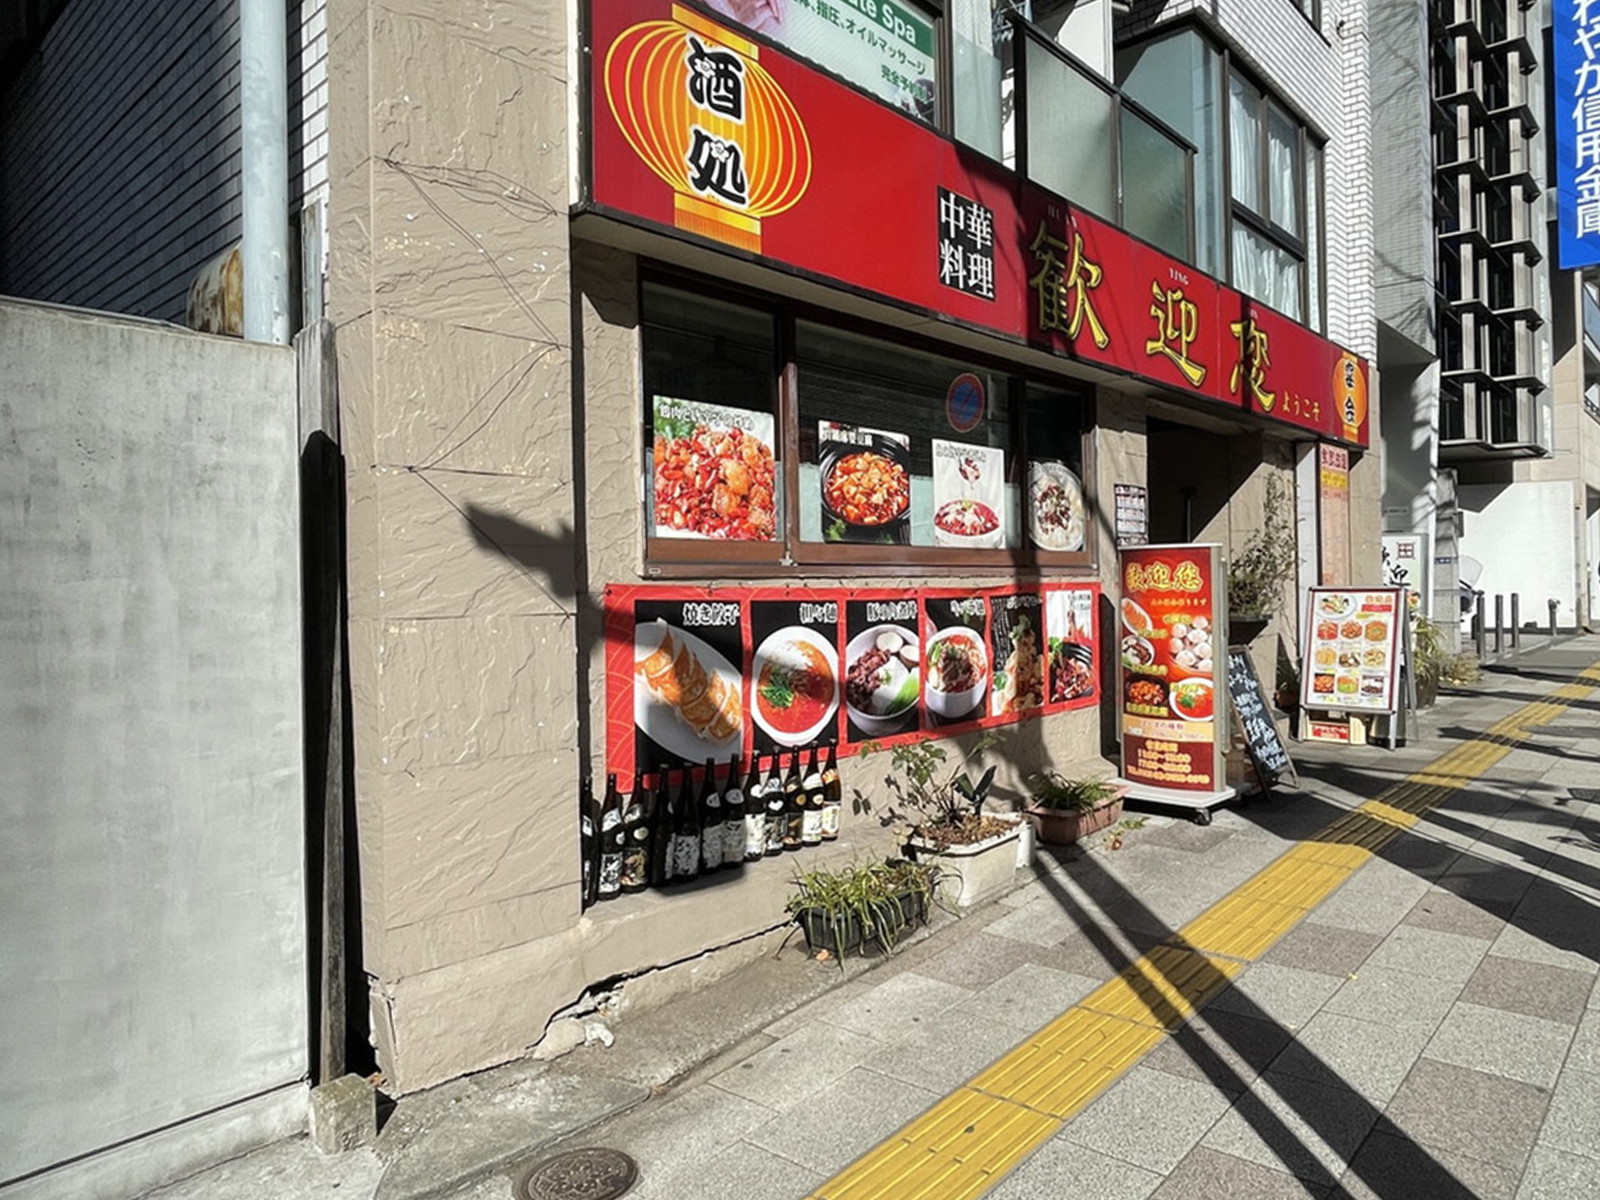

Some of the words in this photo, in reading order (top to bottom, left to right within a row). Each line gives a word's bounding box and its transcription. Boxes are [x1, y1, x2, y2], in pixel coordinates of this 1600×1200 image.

[882, 3, 916, 46] Spa
[686, 34, 750, 208] 酒処
[940, 192, 993, 250] 中華
[940, 238, 994, 299] 料理
[1283, 391, 1320, 422] ようこそ
